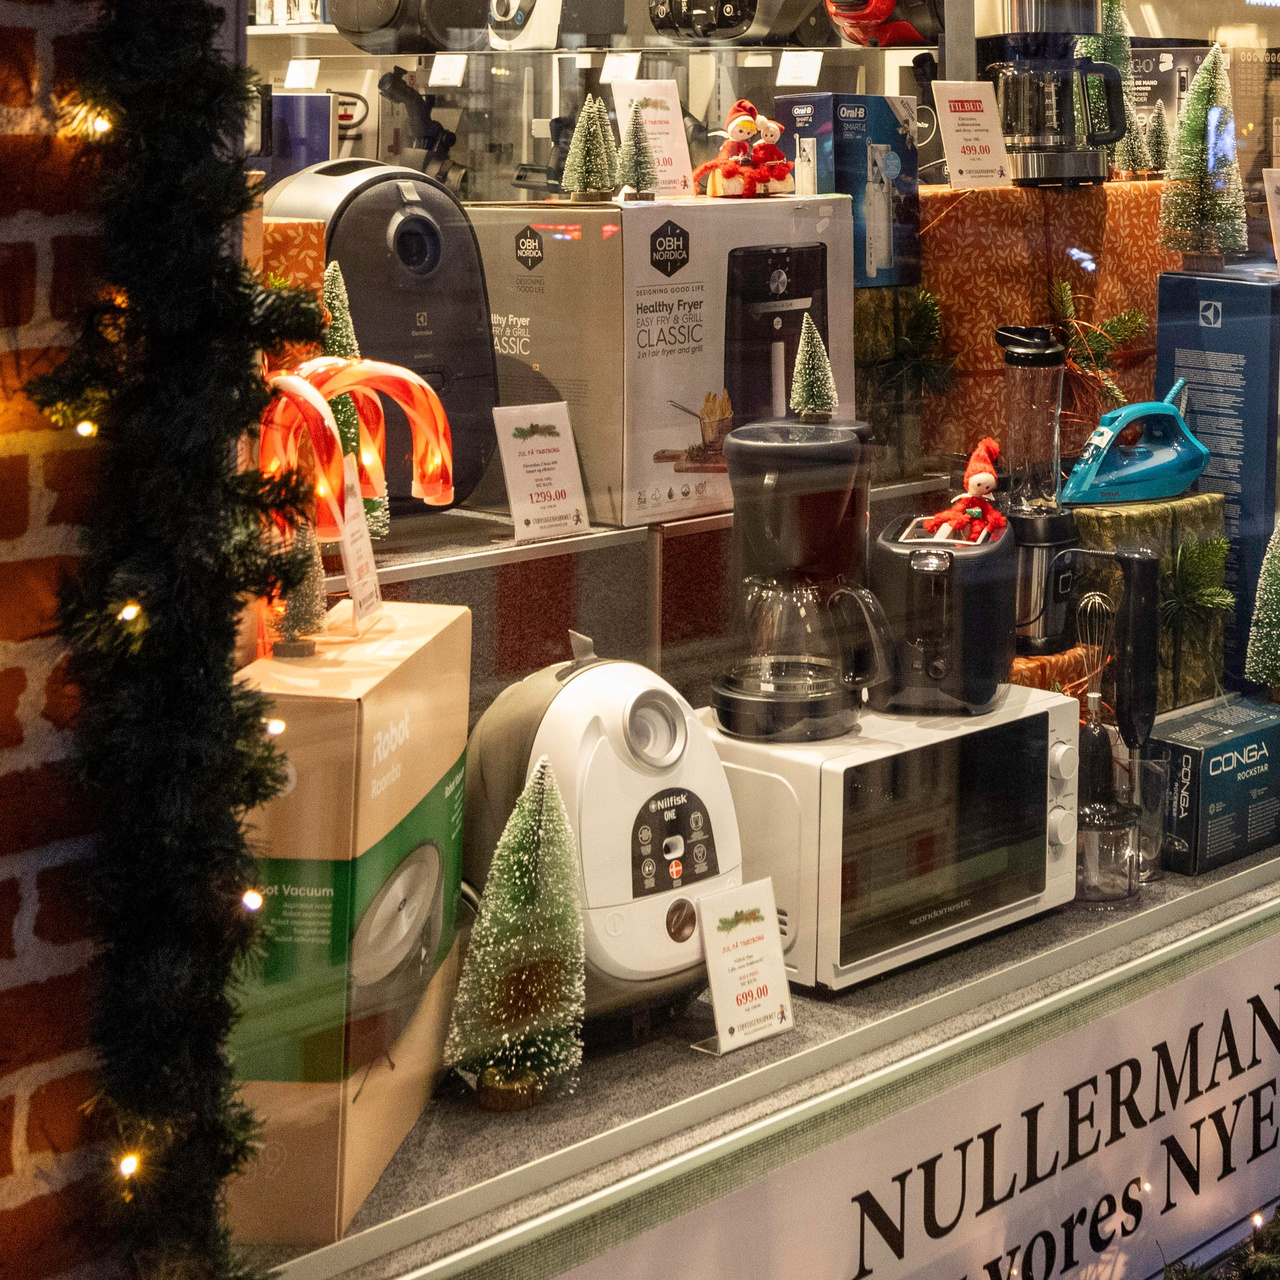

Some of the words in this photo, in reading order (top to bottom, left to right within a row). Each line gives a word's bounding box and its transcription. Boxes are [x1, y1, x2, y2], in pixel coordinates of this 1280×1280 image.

[793, 105, 812, 116] Oral-B
[840, 107, 865, 118] Oral-B
[950, 102, 983, 111] TILBUD
[843, 123, 861, 131] SMART
[861, 123, 866, 132] 4
[961, 145, 991, 156] 499.00
[519, 238, 539, 250] OBH
[656, 237, 683, 250] OBH
[517, 249, 542, 258] NORDICA
[652, 250, 688, 261] NORDICA
[636, 287, 668, 297] DESIGNING
[636, 301, 674, 316] Healthy
[677, 299, 704, 313] Fryer
[508, 314, 531, 328] Fryer
[636, 317, 654, 329] EASY
[656, 316, 670, 325] FRY
[672, 315, 679, 324] &
[682, 313, 703, 323] GRILL
[492, 326, 503, 336] FRY
[505, 327, 511, 336] &
[512, 328, 531, 337] GRILL
[636, 324, 703, 349] CLASSIC
[494, 337, 531, 355] ASSIC
[661, 347, 676, 357] fryer
[678, 346, 690, 354] and
[529, 489, 567, 505] 1299.00
[1209, 742, 1269, 776] CONGA
[1237, 764, 1269, 781] ROCKSTAR
[1179, 754, 1192, 819] CONGA
[657, 793, 688, 810] Nilfisk
[664, 809, 677, 821] ONE
[282, 884, 334, 897] Vacuum
[736, 984, 769, 1007] 699.00
[983, 1176, 1144, 1280] vores
[1159, 1076, 1280, 1216] NYE
